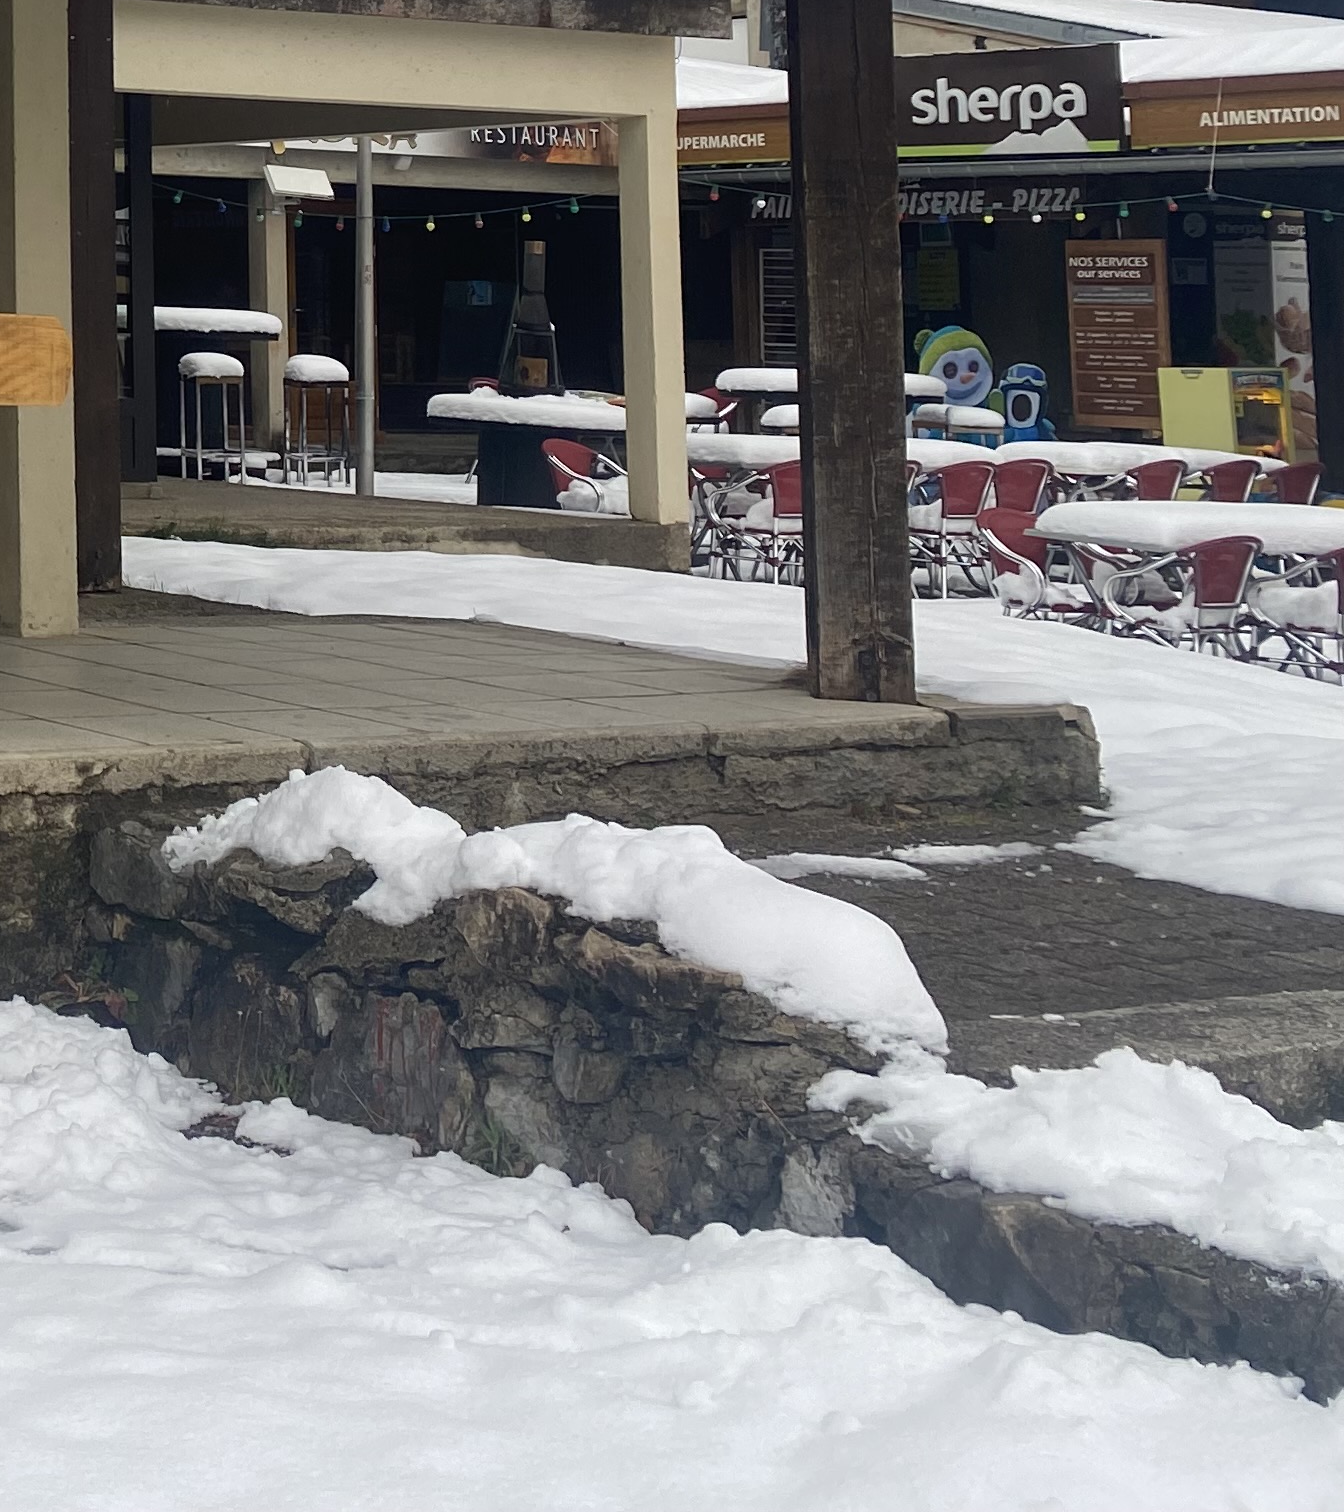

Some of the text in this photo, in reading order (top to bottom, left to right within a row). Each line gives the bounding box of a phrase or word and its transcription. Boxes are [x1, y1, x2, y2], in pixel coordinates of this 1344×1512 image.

[911, 76, 1088, 131] sherpa
[1199, 105, 1340, 127] ALIMENTATION
[470, 126, 600, 150] RESTAURANT
[676, 133, 766, 150] UPERMARCHE
[898, 190, 985, 216] OISERIE
[1068, 256, 1149, 268] NOS SERVICES
[1076, 269, 1141, 279] our services
